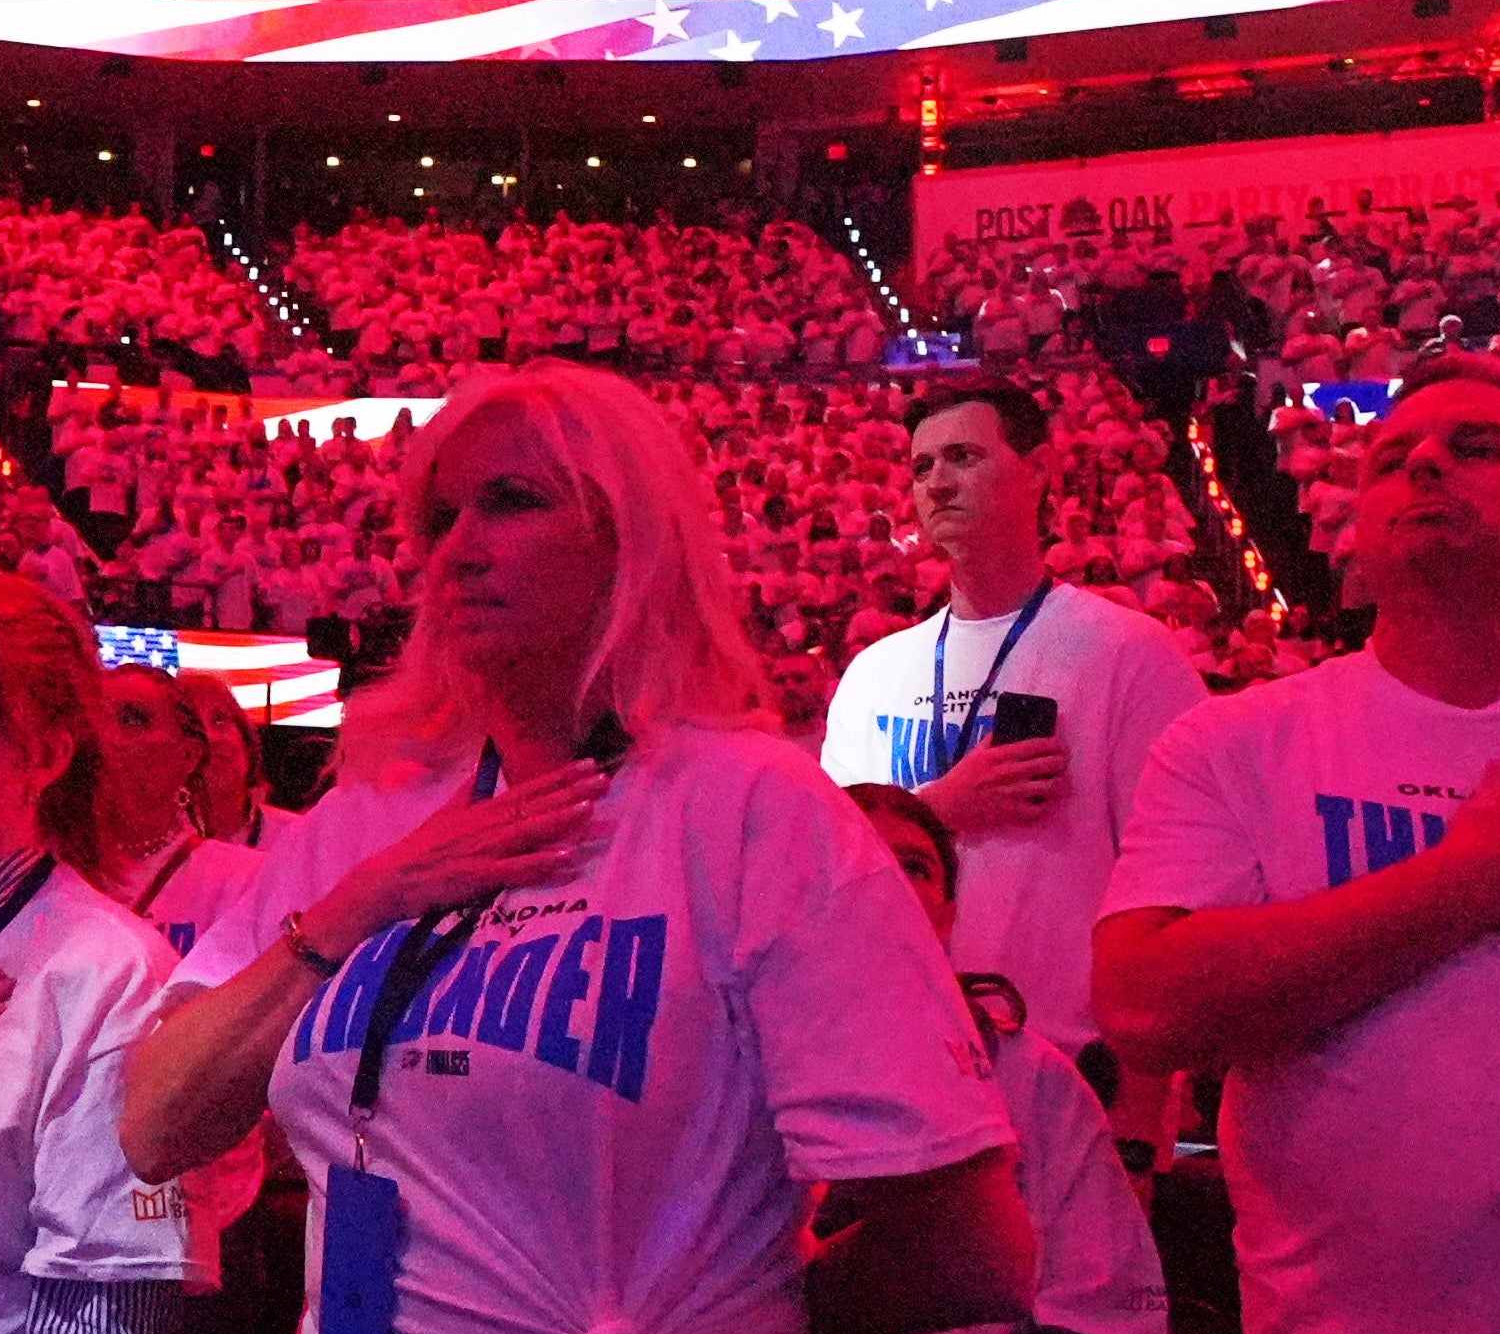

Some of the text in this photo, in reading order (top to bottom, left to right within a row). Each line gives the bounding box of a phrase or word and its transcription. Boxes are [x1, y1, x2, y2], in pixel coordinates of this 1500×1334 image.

[975, 166, 1500, 241] POST OAK PARTY TERRACE
